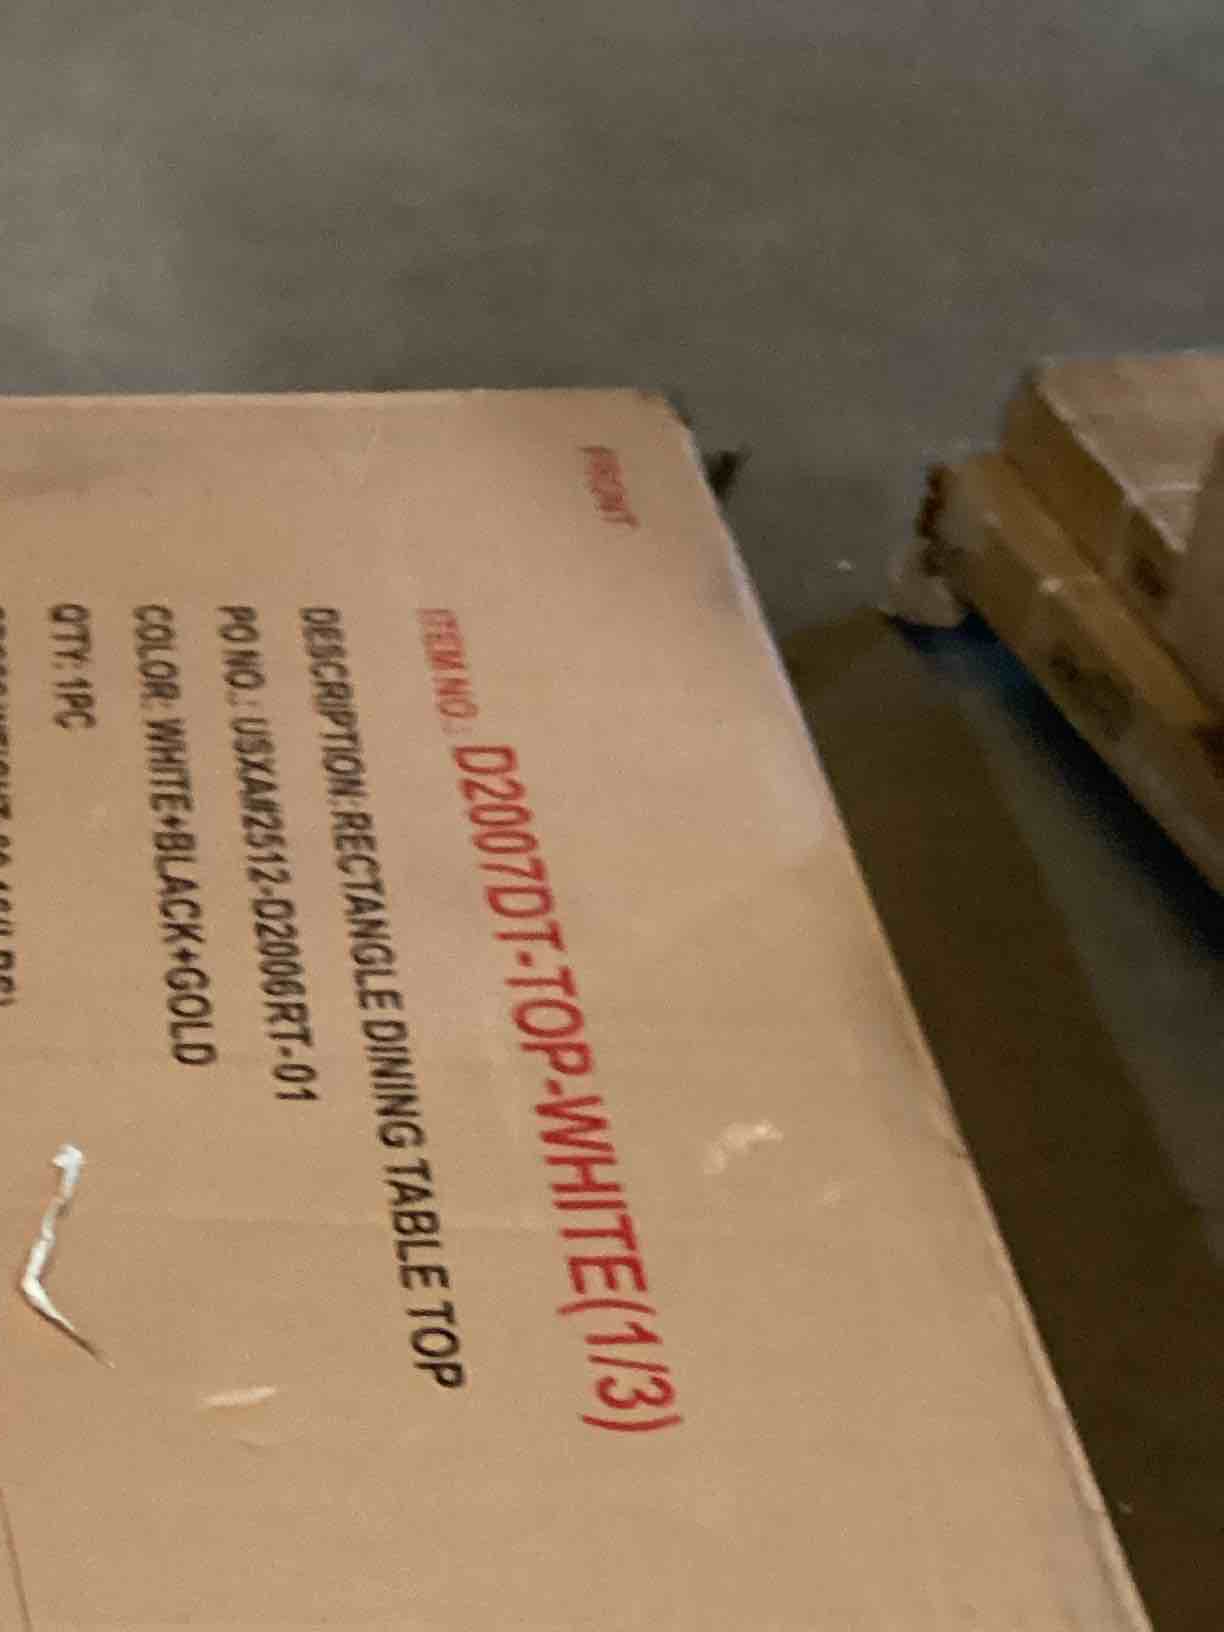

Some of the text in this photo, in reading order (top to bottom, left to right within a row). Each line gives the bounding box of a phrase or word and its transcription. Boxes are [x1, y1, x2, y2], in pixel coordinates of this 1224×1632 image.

[217, 605, 259, 642] PO
[52, 677, 95, 730] 1PC
[133, 604, 217, 1067] COLOR: WHITE+BLACK+GOLD
[360, 1019, 425, 1149] DINING
[416, 608, 469, 671] ITEM
[451, 745, 683, 1433] D2007DT-TOP-WHITE(1/3)
[384, 1158, 449, 1289] TABLE
[406, 1301, 466, 1389] TOP
